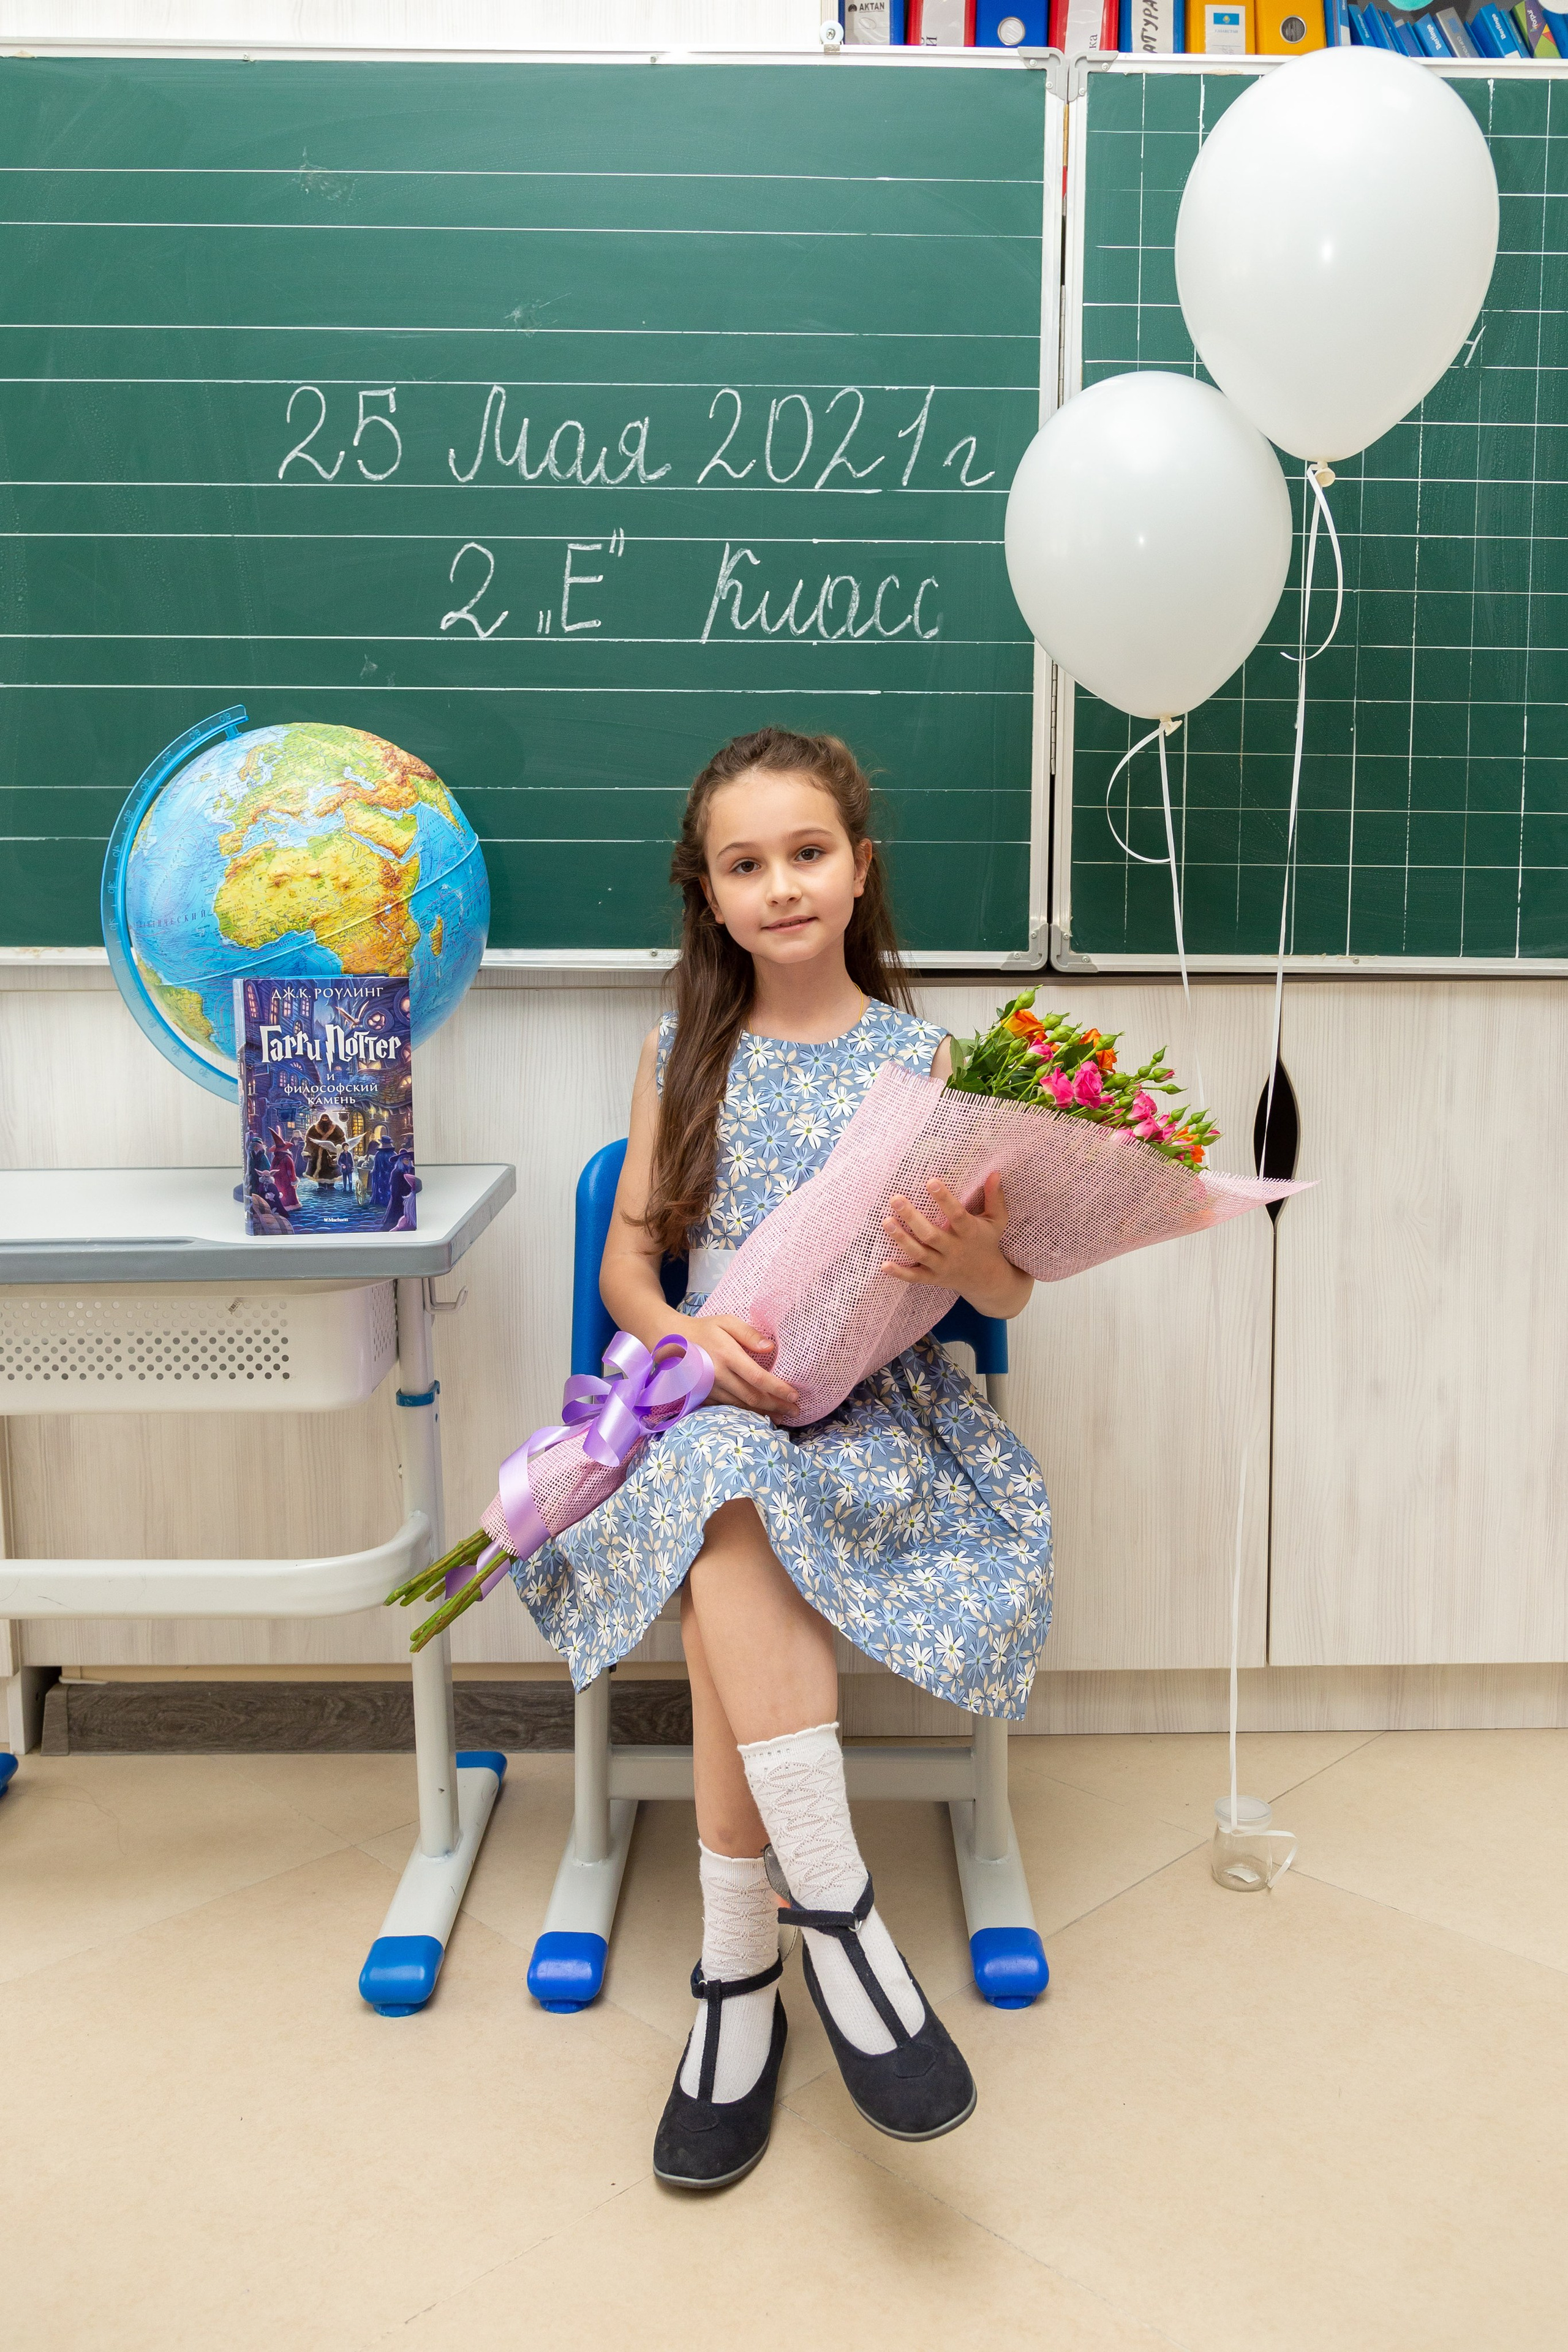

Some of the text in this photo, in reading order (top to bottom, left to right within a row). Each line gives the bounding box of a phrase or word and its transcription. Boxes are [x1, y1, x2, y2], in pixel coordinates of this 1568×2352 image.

[1427, 24, 1442, 50] Berlingo
[1491, 13, 1506, 40] Berlingo
[278, 386, 402, 481] 25
[448, 385, 672, 484] Мая
[697, 385, 935, 489] 2021
[440, 542, 508, 638] 2
[314, 987, 383, 1000] РОУЛИНГ
